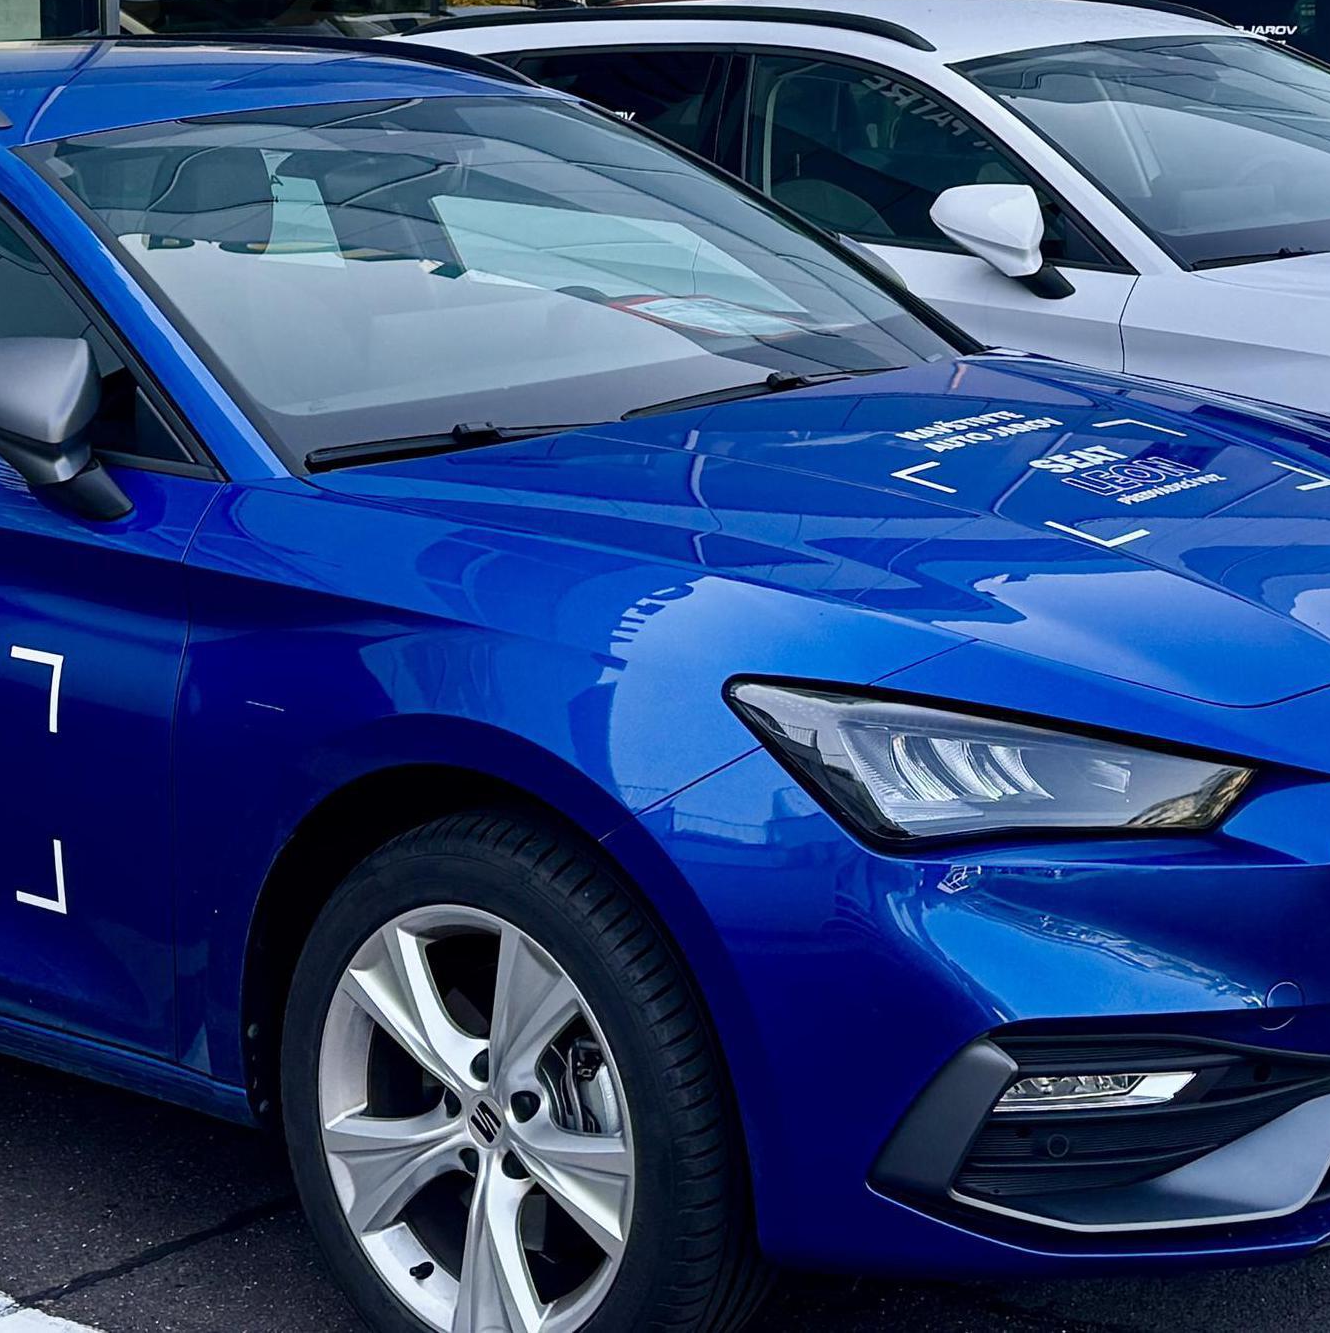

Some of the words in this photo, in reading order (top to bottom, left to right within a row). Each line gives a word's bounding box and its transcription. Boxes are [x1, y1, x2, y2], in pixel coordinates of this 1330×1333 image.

[894, 410, 1026, 441] NAVŠTIVTE
[923, 432, 994, 453] AUTO
[987, 417, 1064, 437] JAROV
[1029, 445, 1129, 474] SEAT
[1061, 456, 1201, 497] LEON
